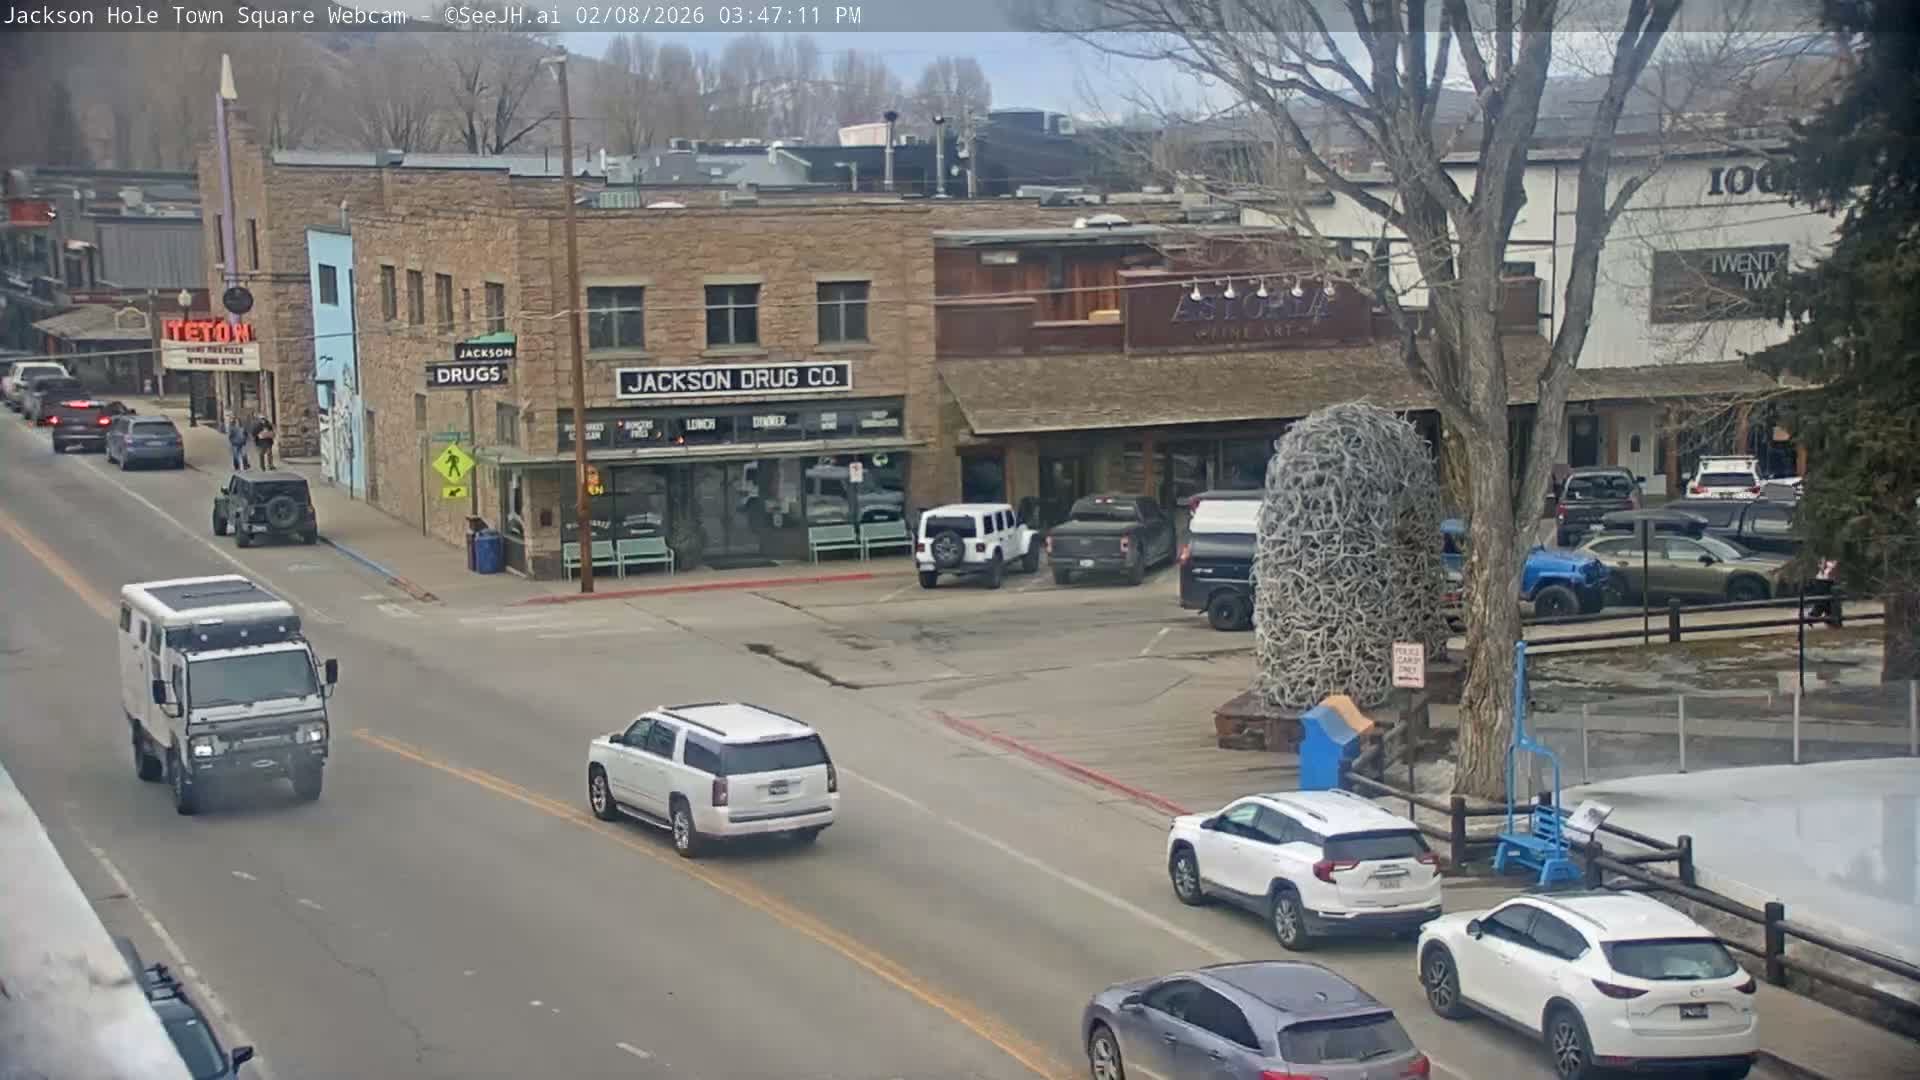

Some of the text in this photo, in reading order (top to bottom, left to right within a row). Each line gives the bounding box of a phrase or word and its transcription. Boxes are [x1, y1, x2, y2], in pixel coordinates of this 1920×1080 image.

[1711, 252, 1785, 273] TWENTY
[167, 320, 251, 344] TETON
[1264, 325, 1292, 337] ART
[460, 348, 513, 359] JACKSON
[437, 367, 501, 383] DRUGS
[628, 367, 840, 392] JACKSON DRUG CO.
[686, 419, 716, 430] LUNCH
[752, 416, 787, 428] DINNER
